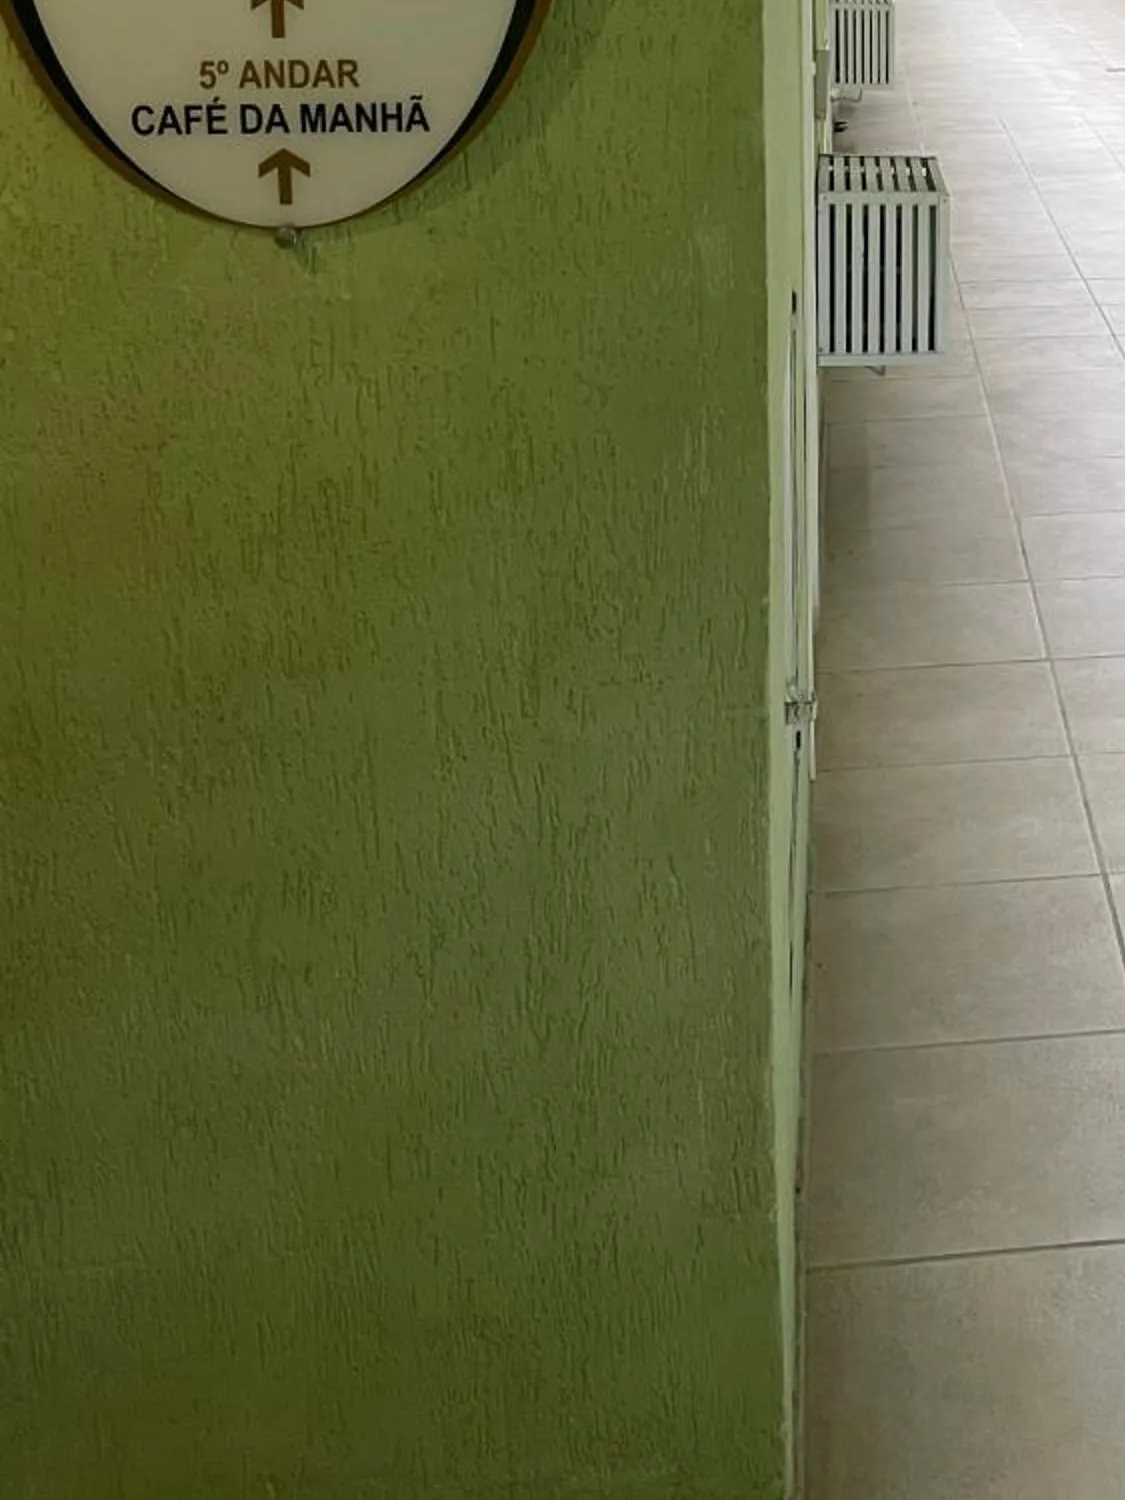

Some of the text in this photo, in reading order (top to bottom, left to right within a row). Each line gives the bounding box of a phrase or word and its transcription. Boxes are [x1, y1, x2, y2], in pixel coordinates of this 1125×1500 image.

[238, 59, 361, 90] ANDAR
[131, 94, 431, 137] CAFÉ DA MANHÃ
